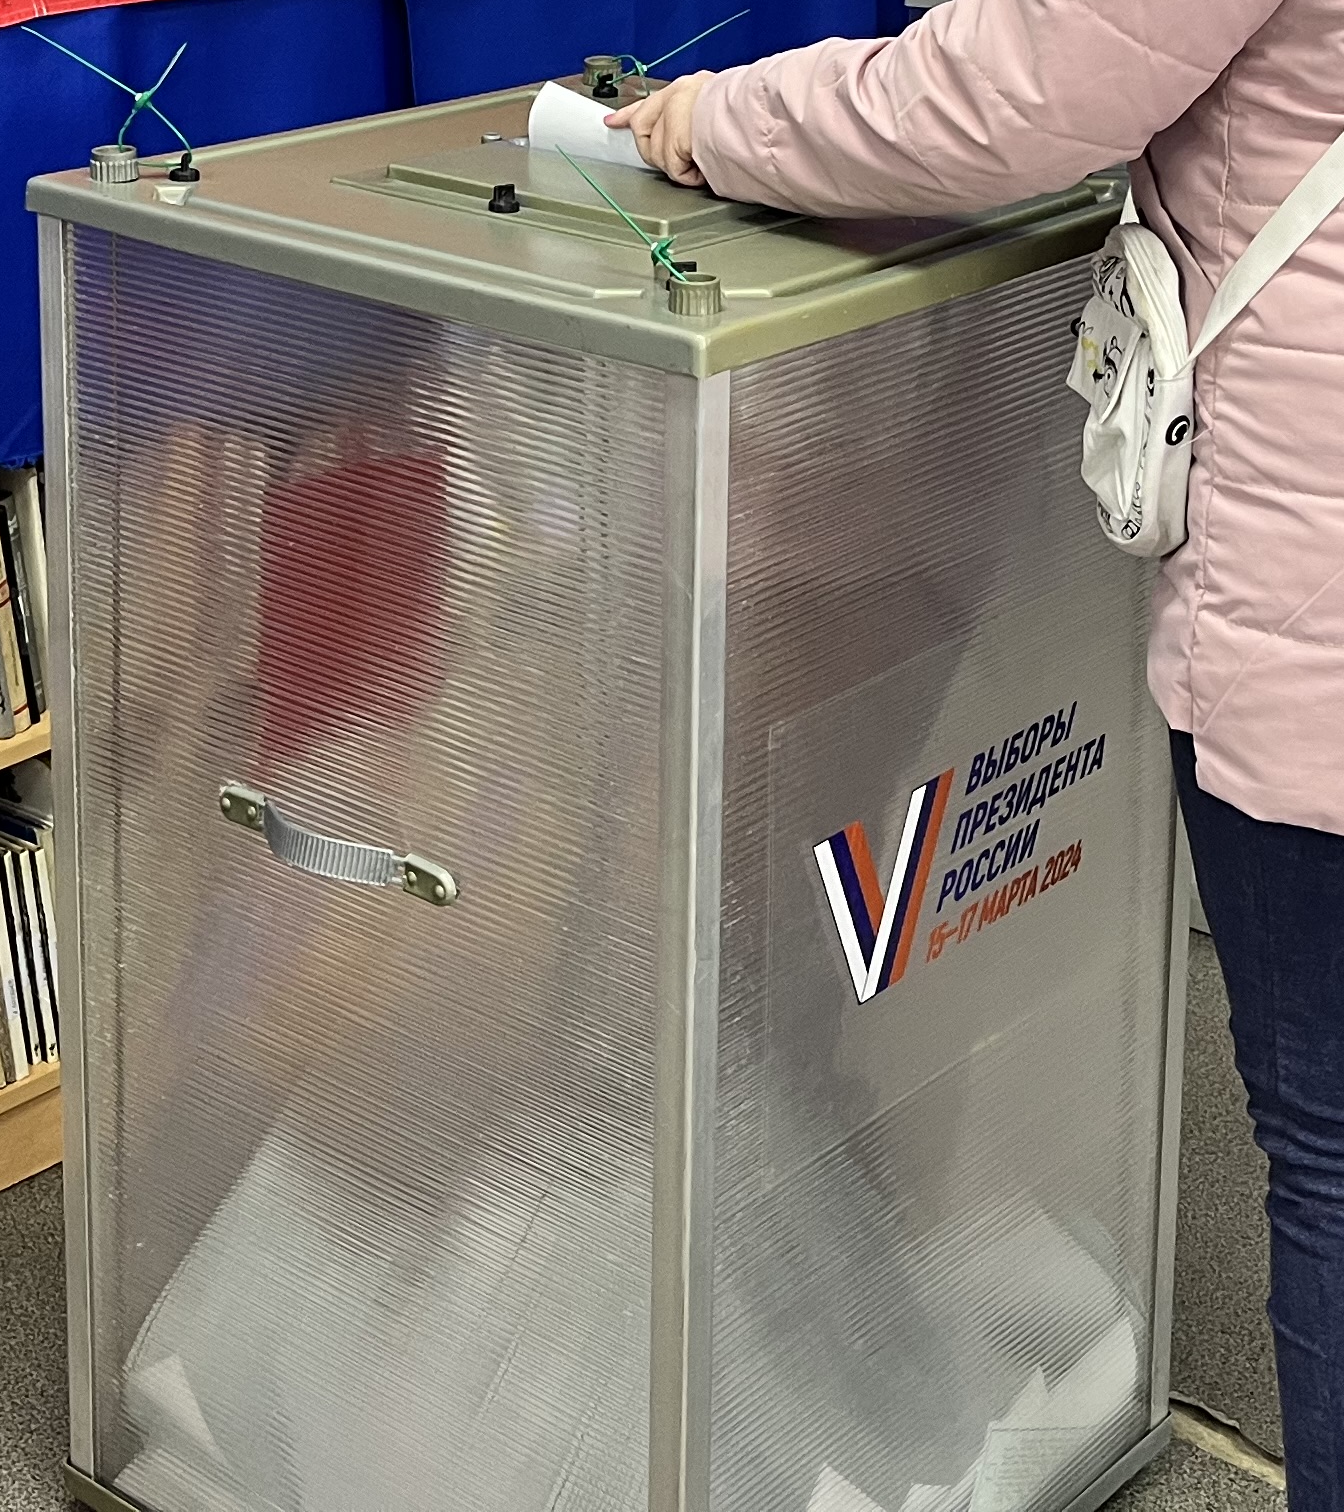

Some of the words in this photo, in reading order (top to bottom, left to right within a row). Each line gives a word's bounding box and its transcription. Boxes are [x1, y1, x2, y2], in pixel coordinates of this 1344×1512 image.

[951, 733, 1106, 855] ПРЕЗИДЕНТА
[965, 700, 1078, 796] ВЫБОРЫ
[936, 818, 1041, 914] РОССИИ
[977, 864, 1039, 933] МАРТА
[1039, 838, 1083, 894] 2024
